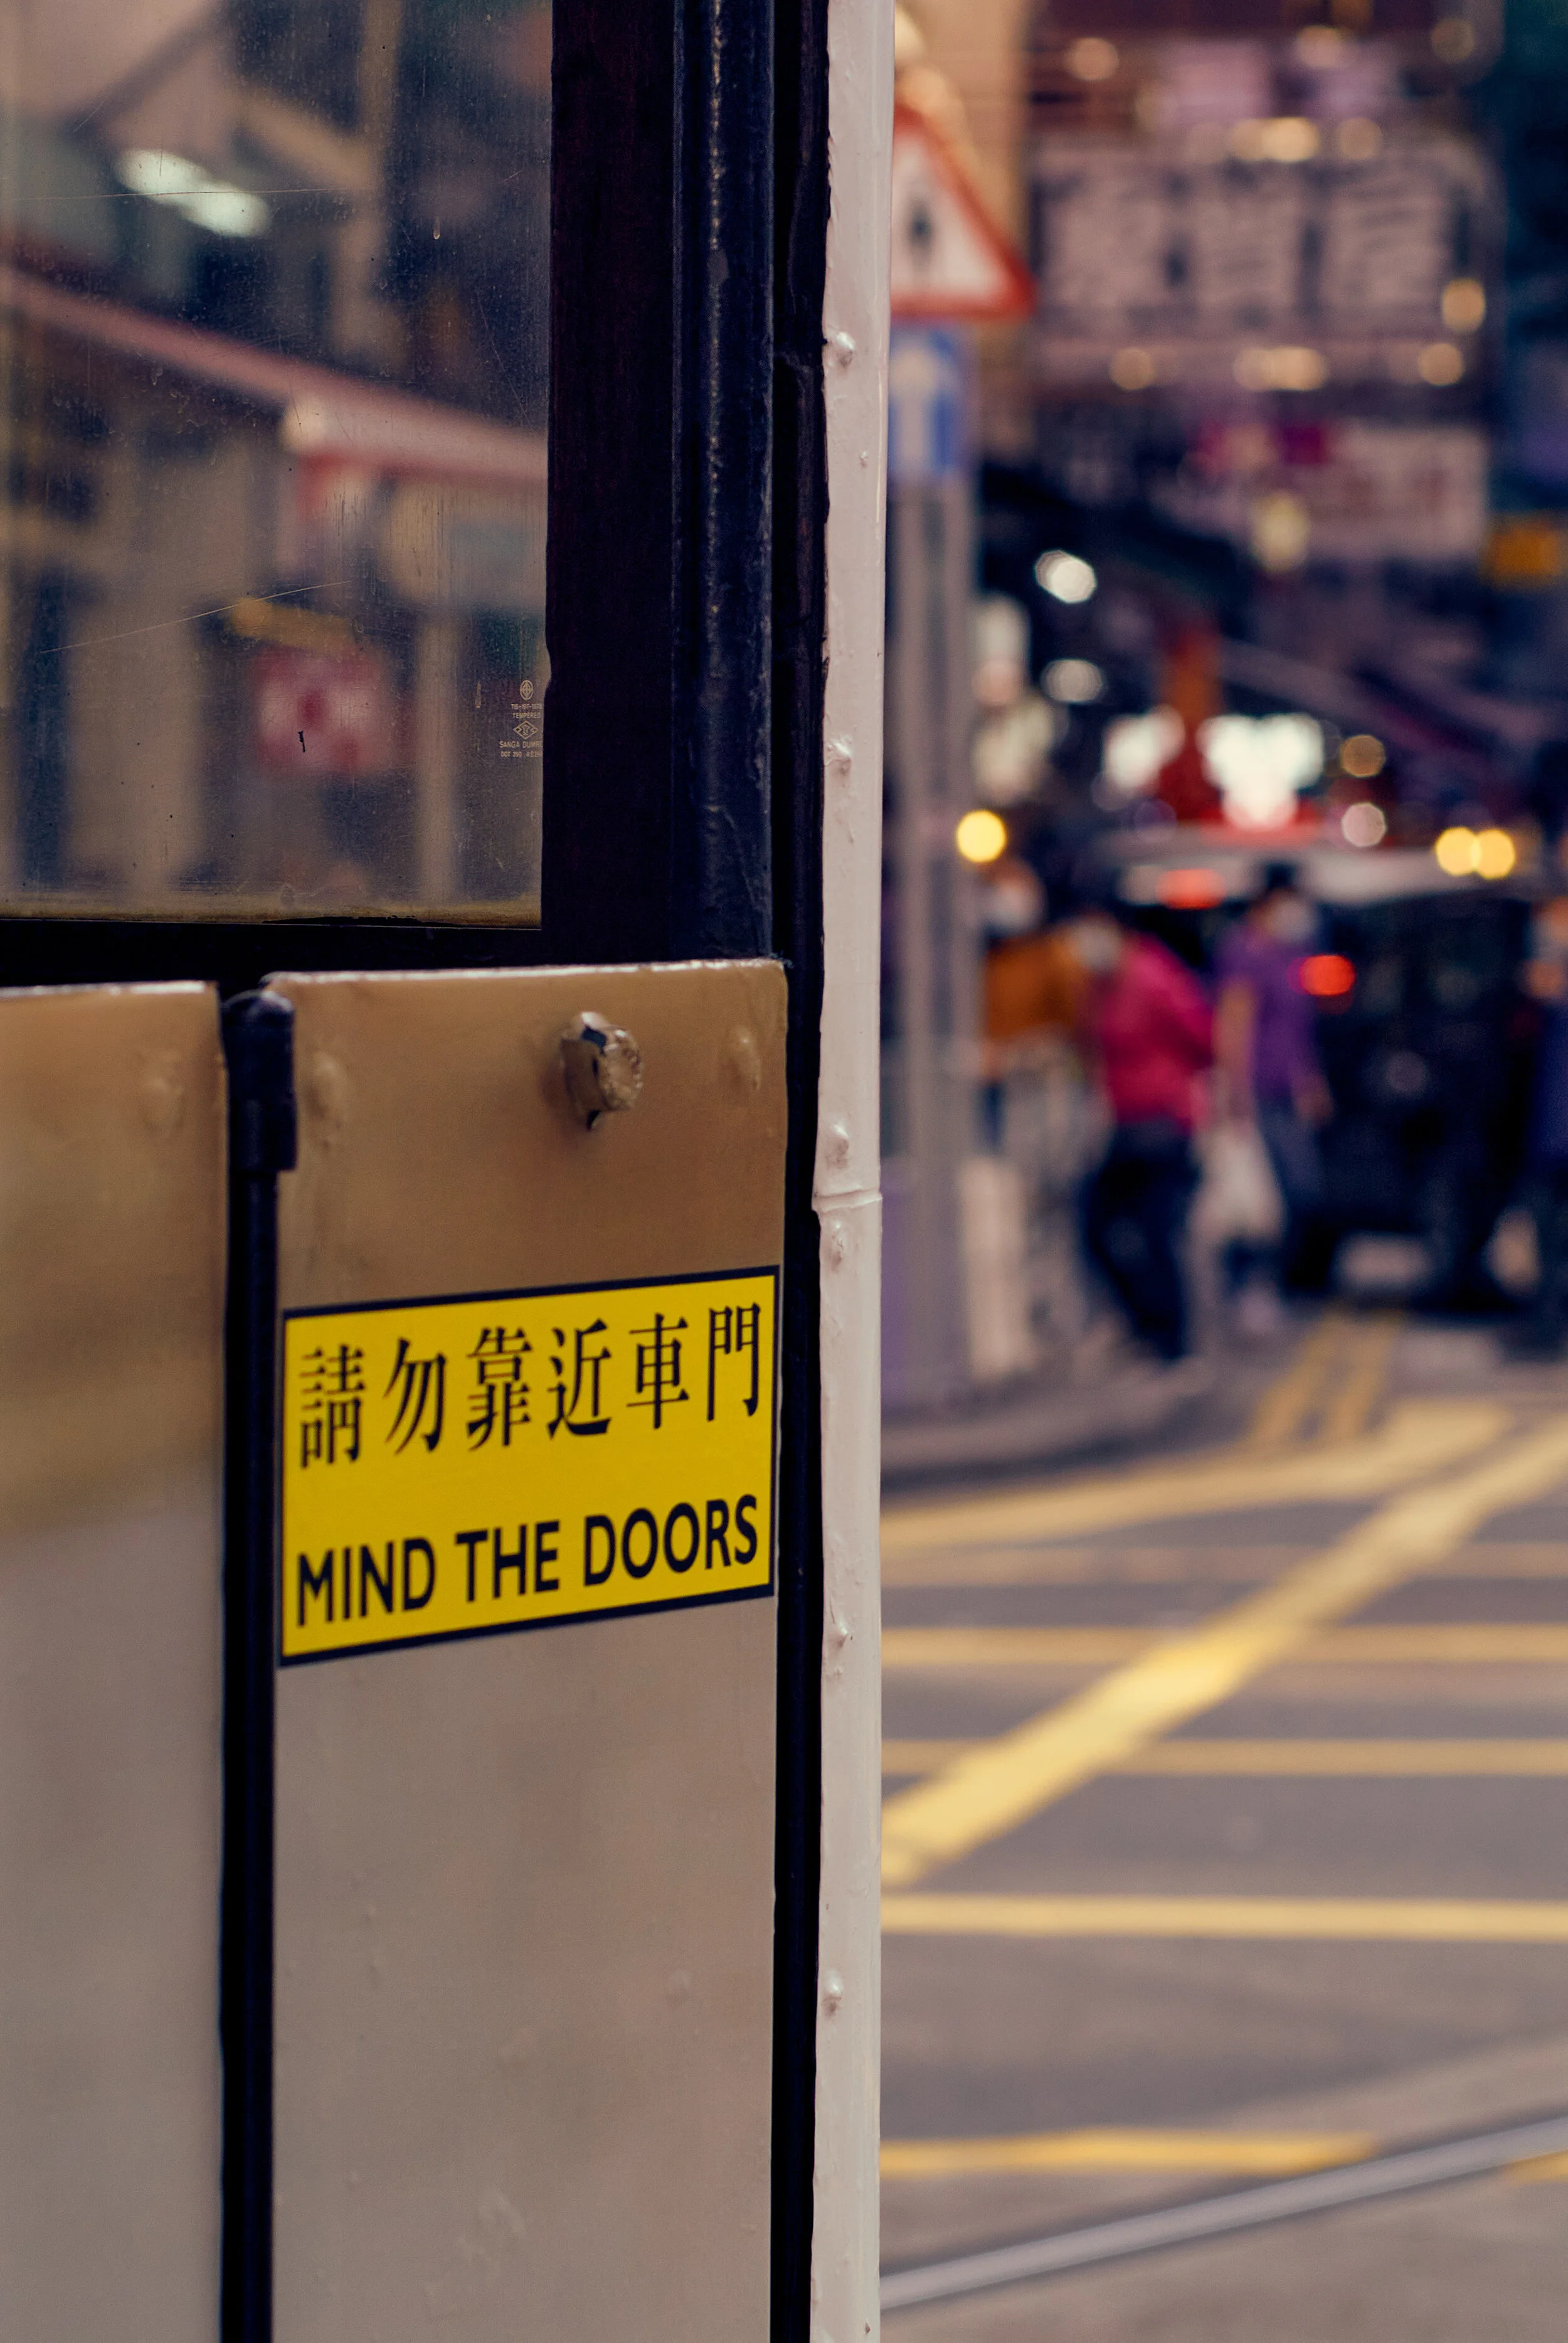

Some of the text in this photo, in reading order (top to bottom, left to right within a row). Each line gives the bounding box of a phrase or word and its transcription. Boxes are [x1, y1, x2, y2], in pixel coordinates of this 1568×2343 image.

[499, 740, 519, 748] SANGA
[299, 1302, 761, 1469] 請勿靠近車門
[297, 1494, 758, 1627] MIND THE DOORS
